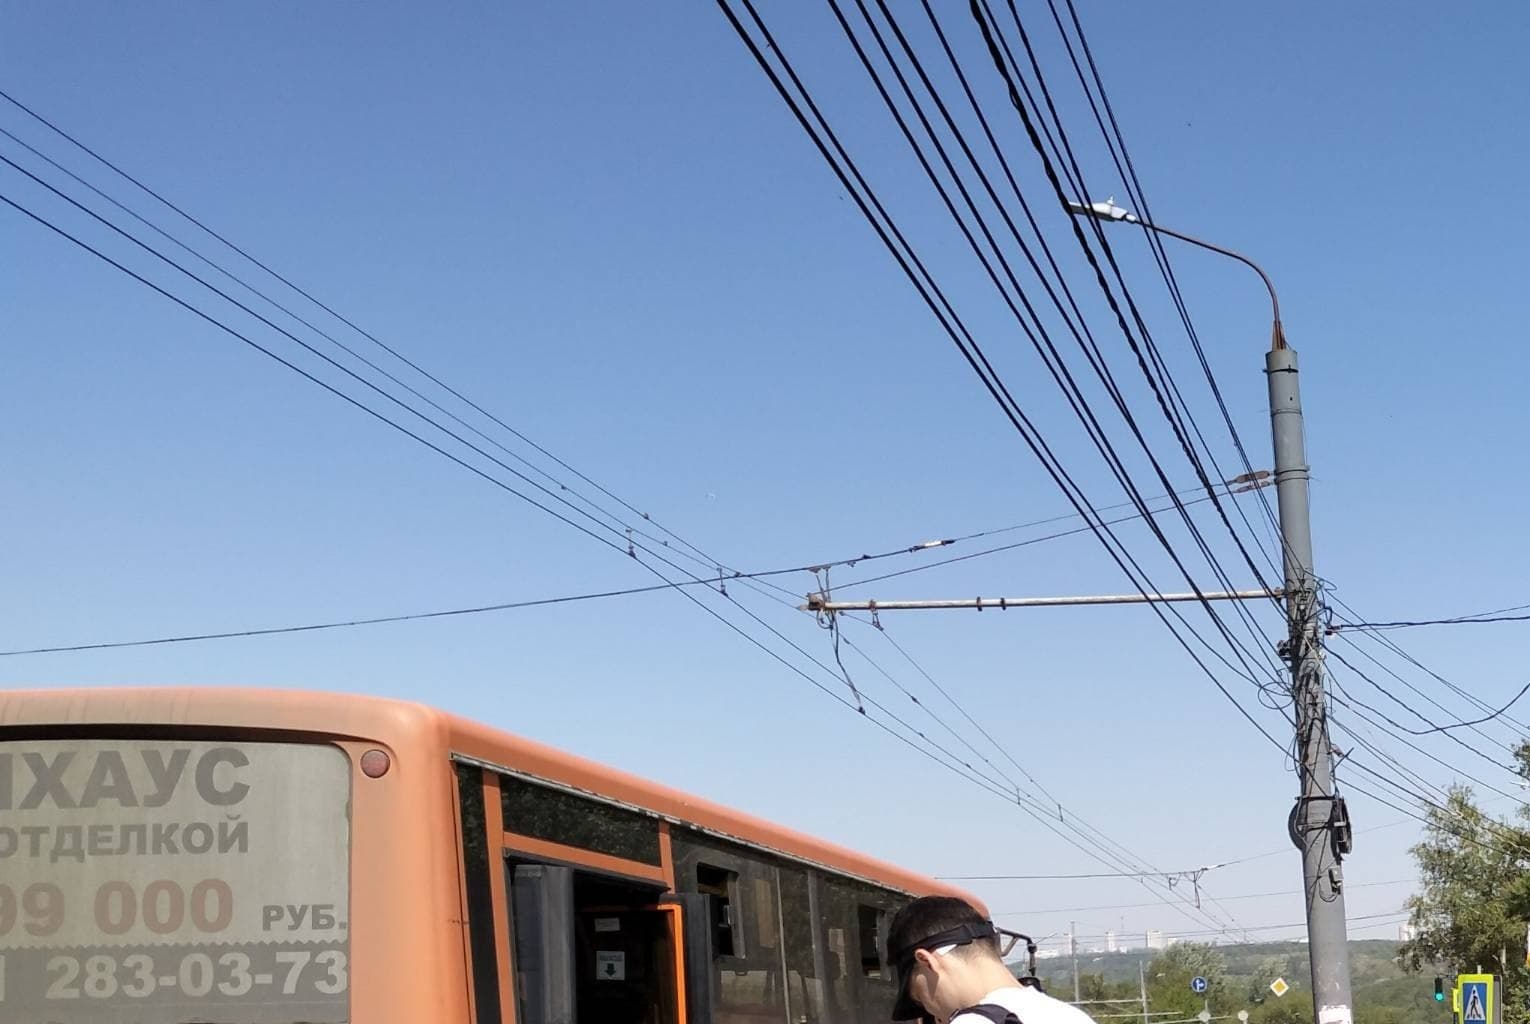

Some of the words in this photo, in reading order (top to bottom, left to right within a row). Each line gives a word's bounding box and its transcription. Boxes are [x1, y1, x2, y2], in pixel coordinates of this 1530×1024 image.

[0, 748, 250, 810] ХАУС
[95, 879, 233, 936] 000
[262, 904, 347, 931] РУБ.
[45, 950, 347, 999] 283-03-73
